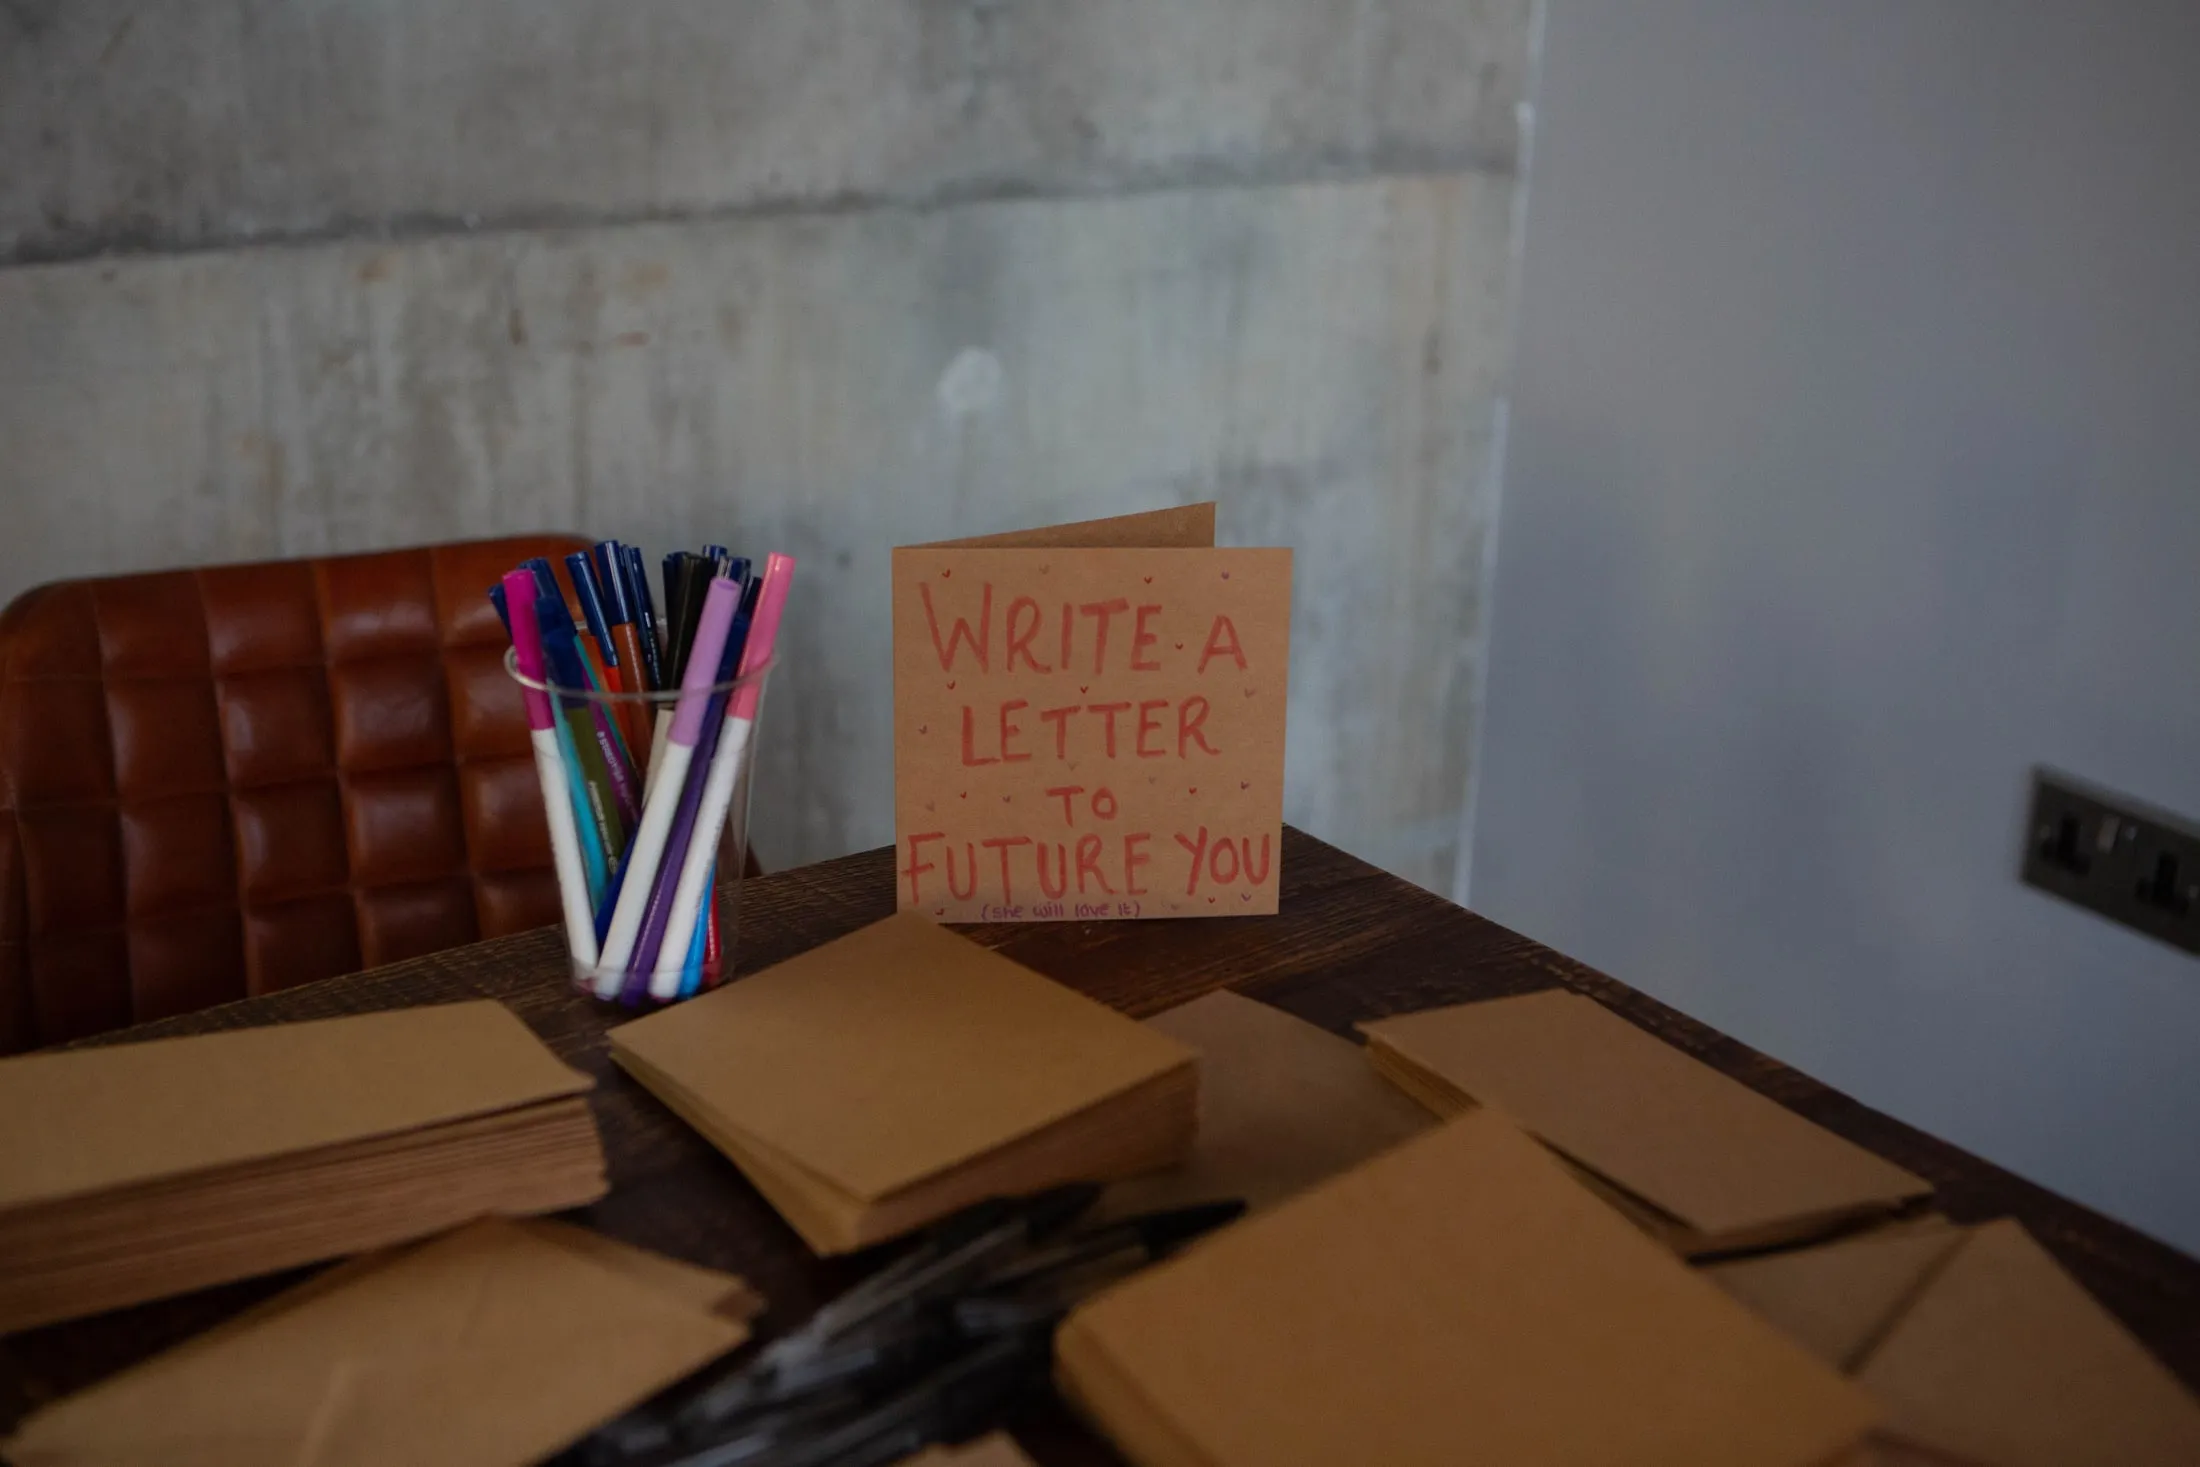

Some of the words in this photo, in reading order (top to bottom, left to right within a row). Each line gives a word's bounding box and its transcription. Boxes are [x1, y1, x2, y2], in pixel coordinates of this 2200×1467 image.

[918, 582, 1163, 674] WRITE
[1197, 614, 1249, 674] A
[961, 695, 1222, 767] LETTER
[1045, 786, 1119, 828] TO
[900, 832, 1151, 905] FUTURE
[1174, 826, 1271, 896] YOU
[1032, 903, 1064, 918] will
[1075, 903, 1111, 918] love
